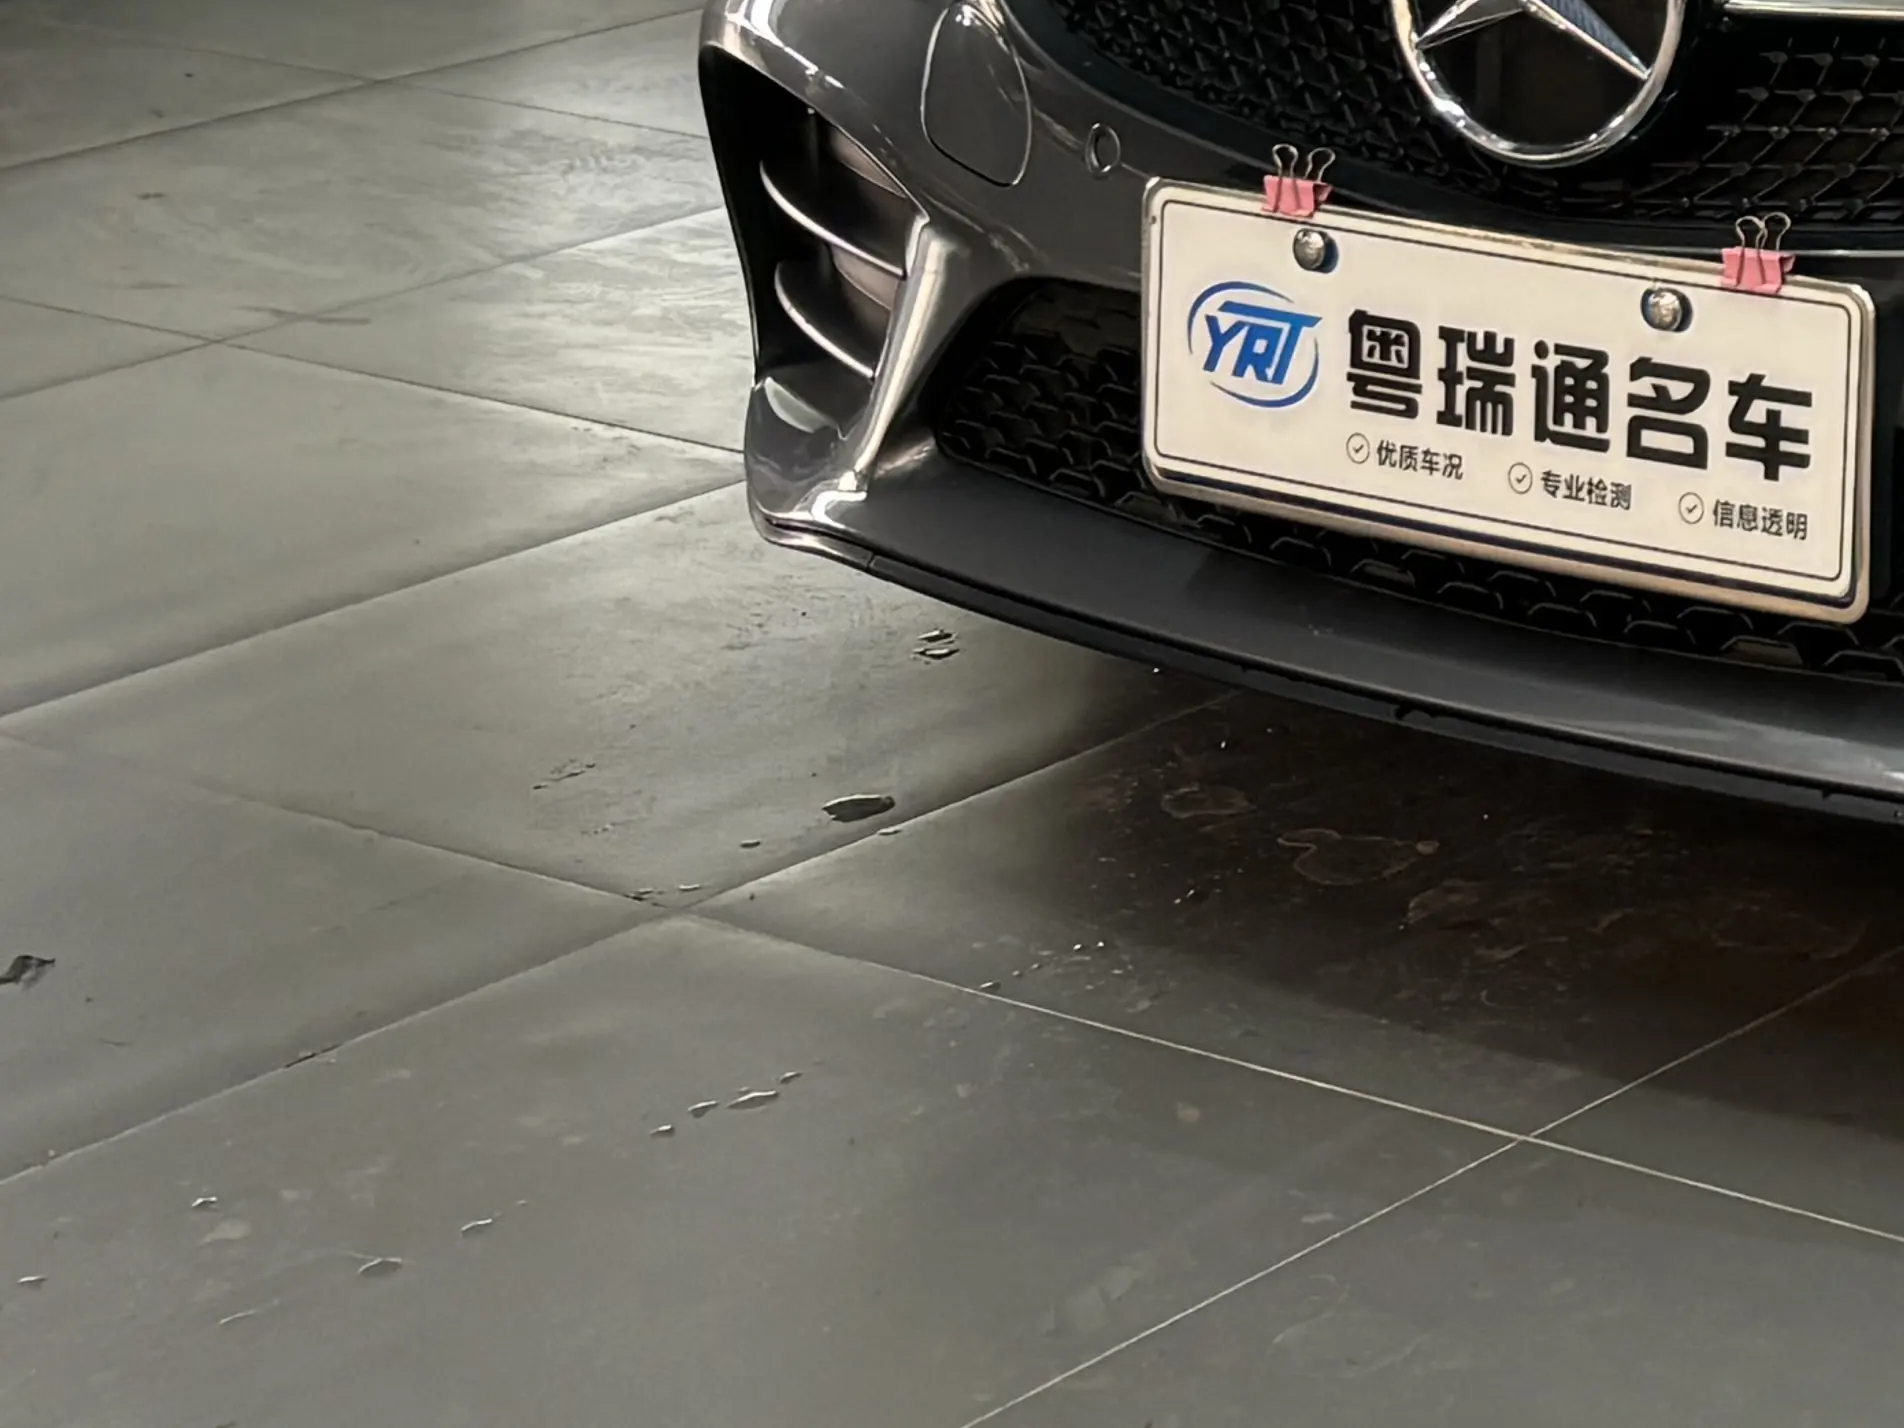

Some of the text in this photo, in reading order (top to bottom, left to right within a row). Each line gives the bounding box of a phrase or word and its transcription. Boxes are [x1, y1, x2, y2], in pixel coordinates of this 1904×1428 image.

[1202, 300, 1323, 386] YRT
[1346, 307, 1813, 482] 粤瑞通名车
[1376, 439, 1464, 481] 优质车况
[1540, 468, 1632, 511] 专业检测
[1712, 498, 1808, 541] 信息透明
